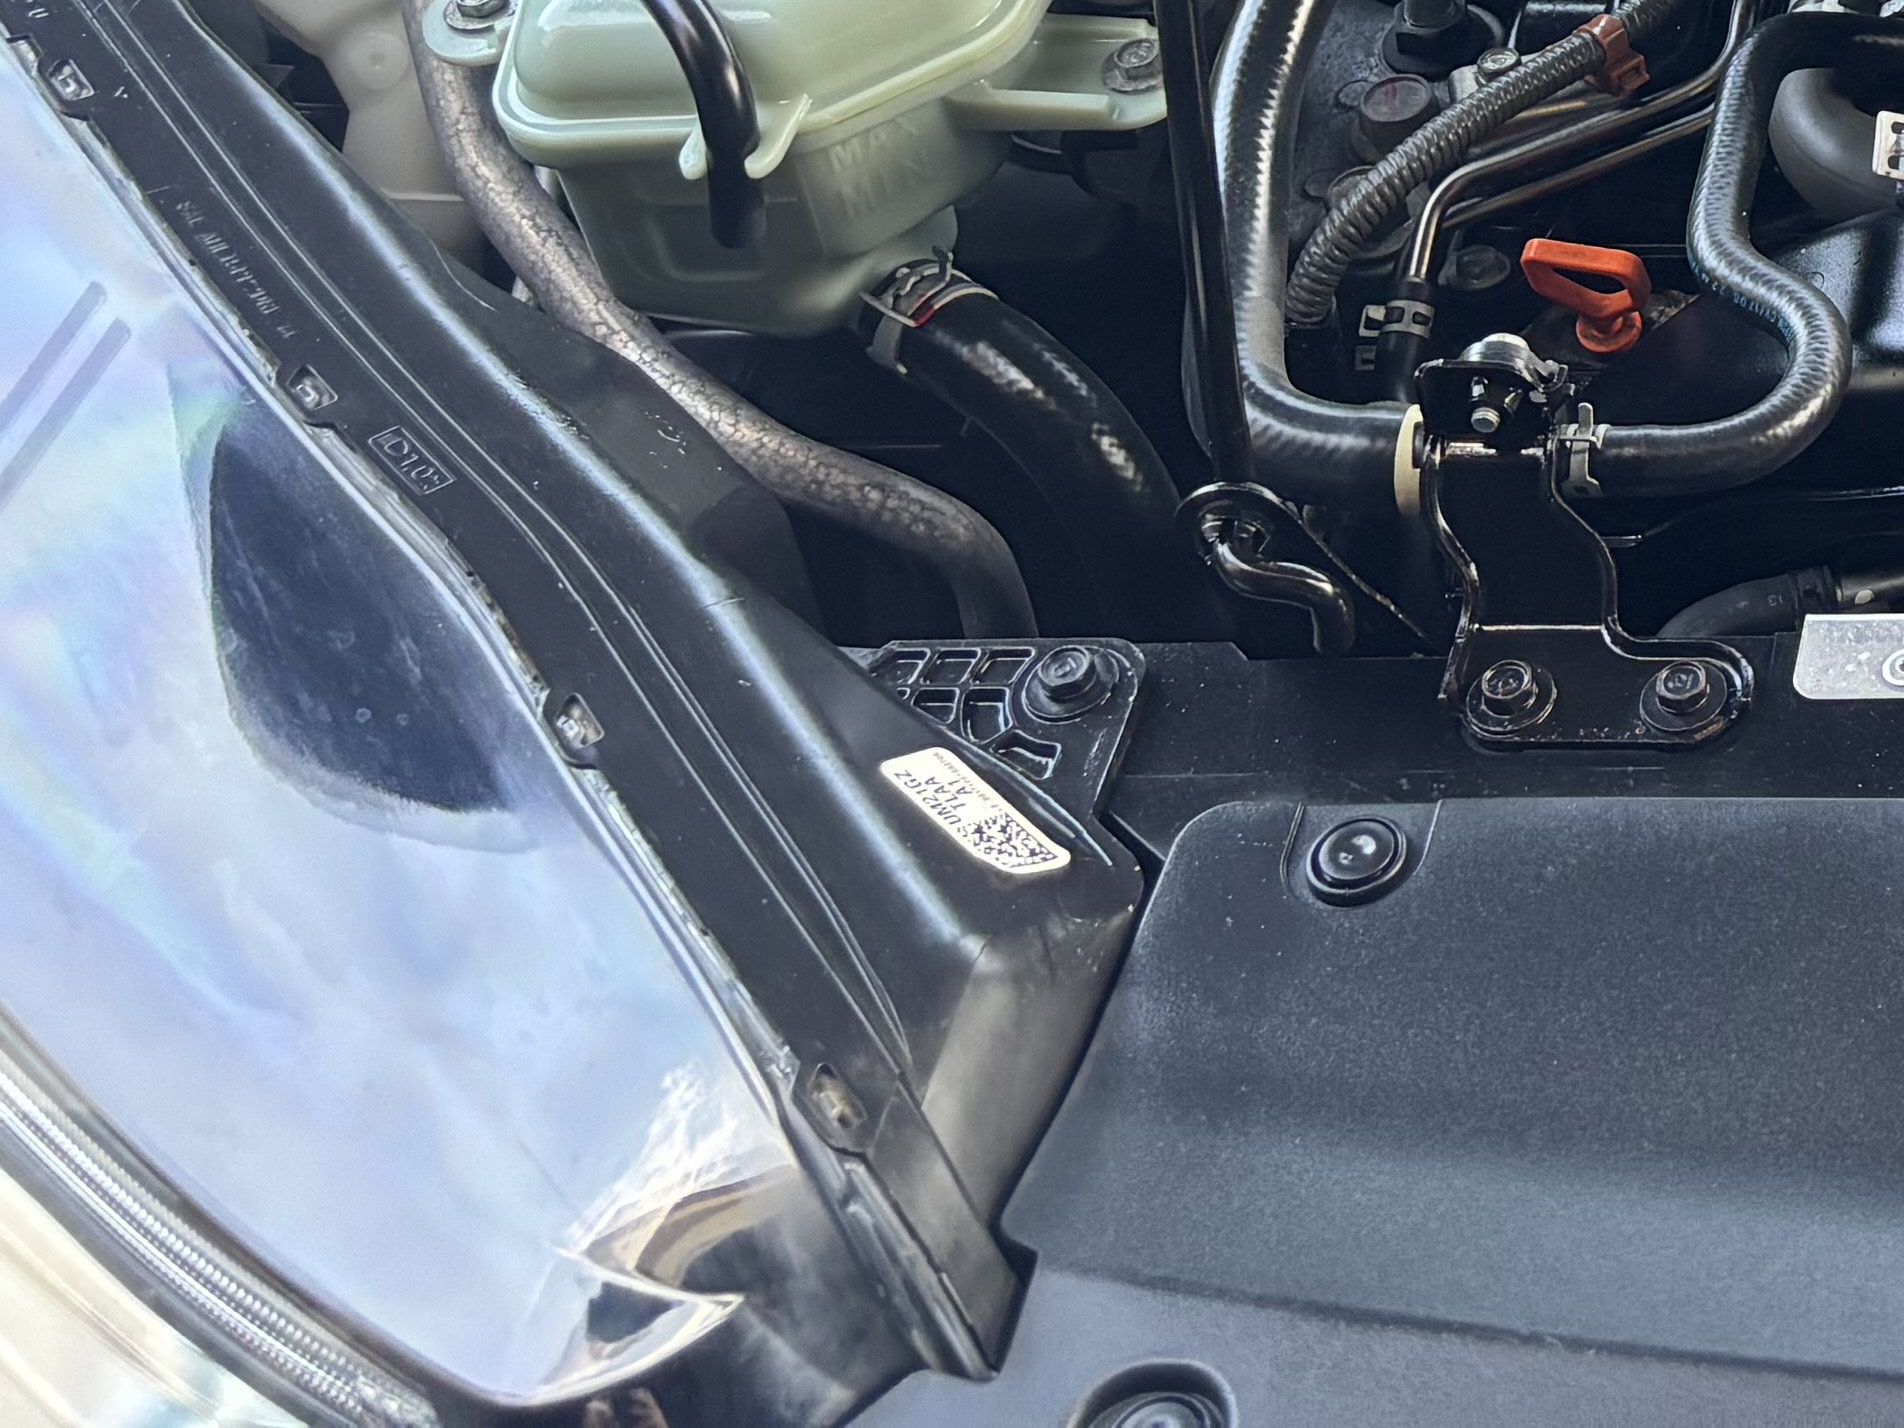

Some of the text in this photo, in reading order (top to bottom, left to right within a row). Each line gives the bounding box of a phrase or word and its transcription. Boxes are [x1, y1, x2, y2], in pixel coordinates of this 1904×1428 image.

[894, 768, 962, 825] UM21GZ
[924, 775, 966, 810] TLAA
[948, 779, 974, 795] A1
